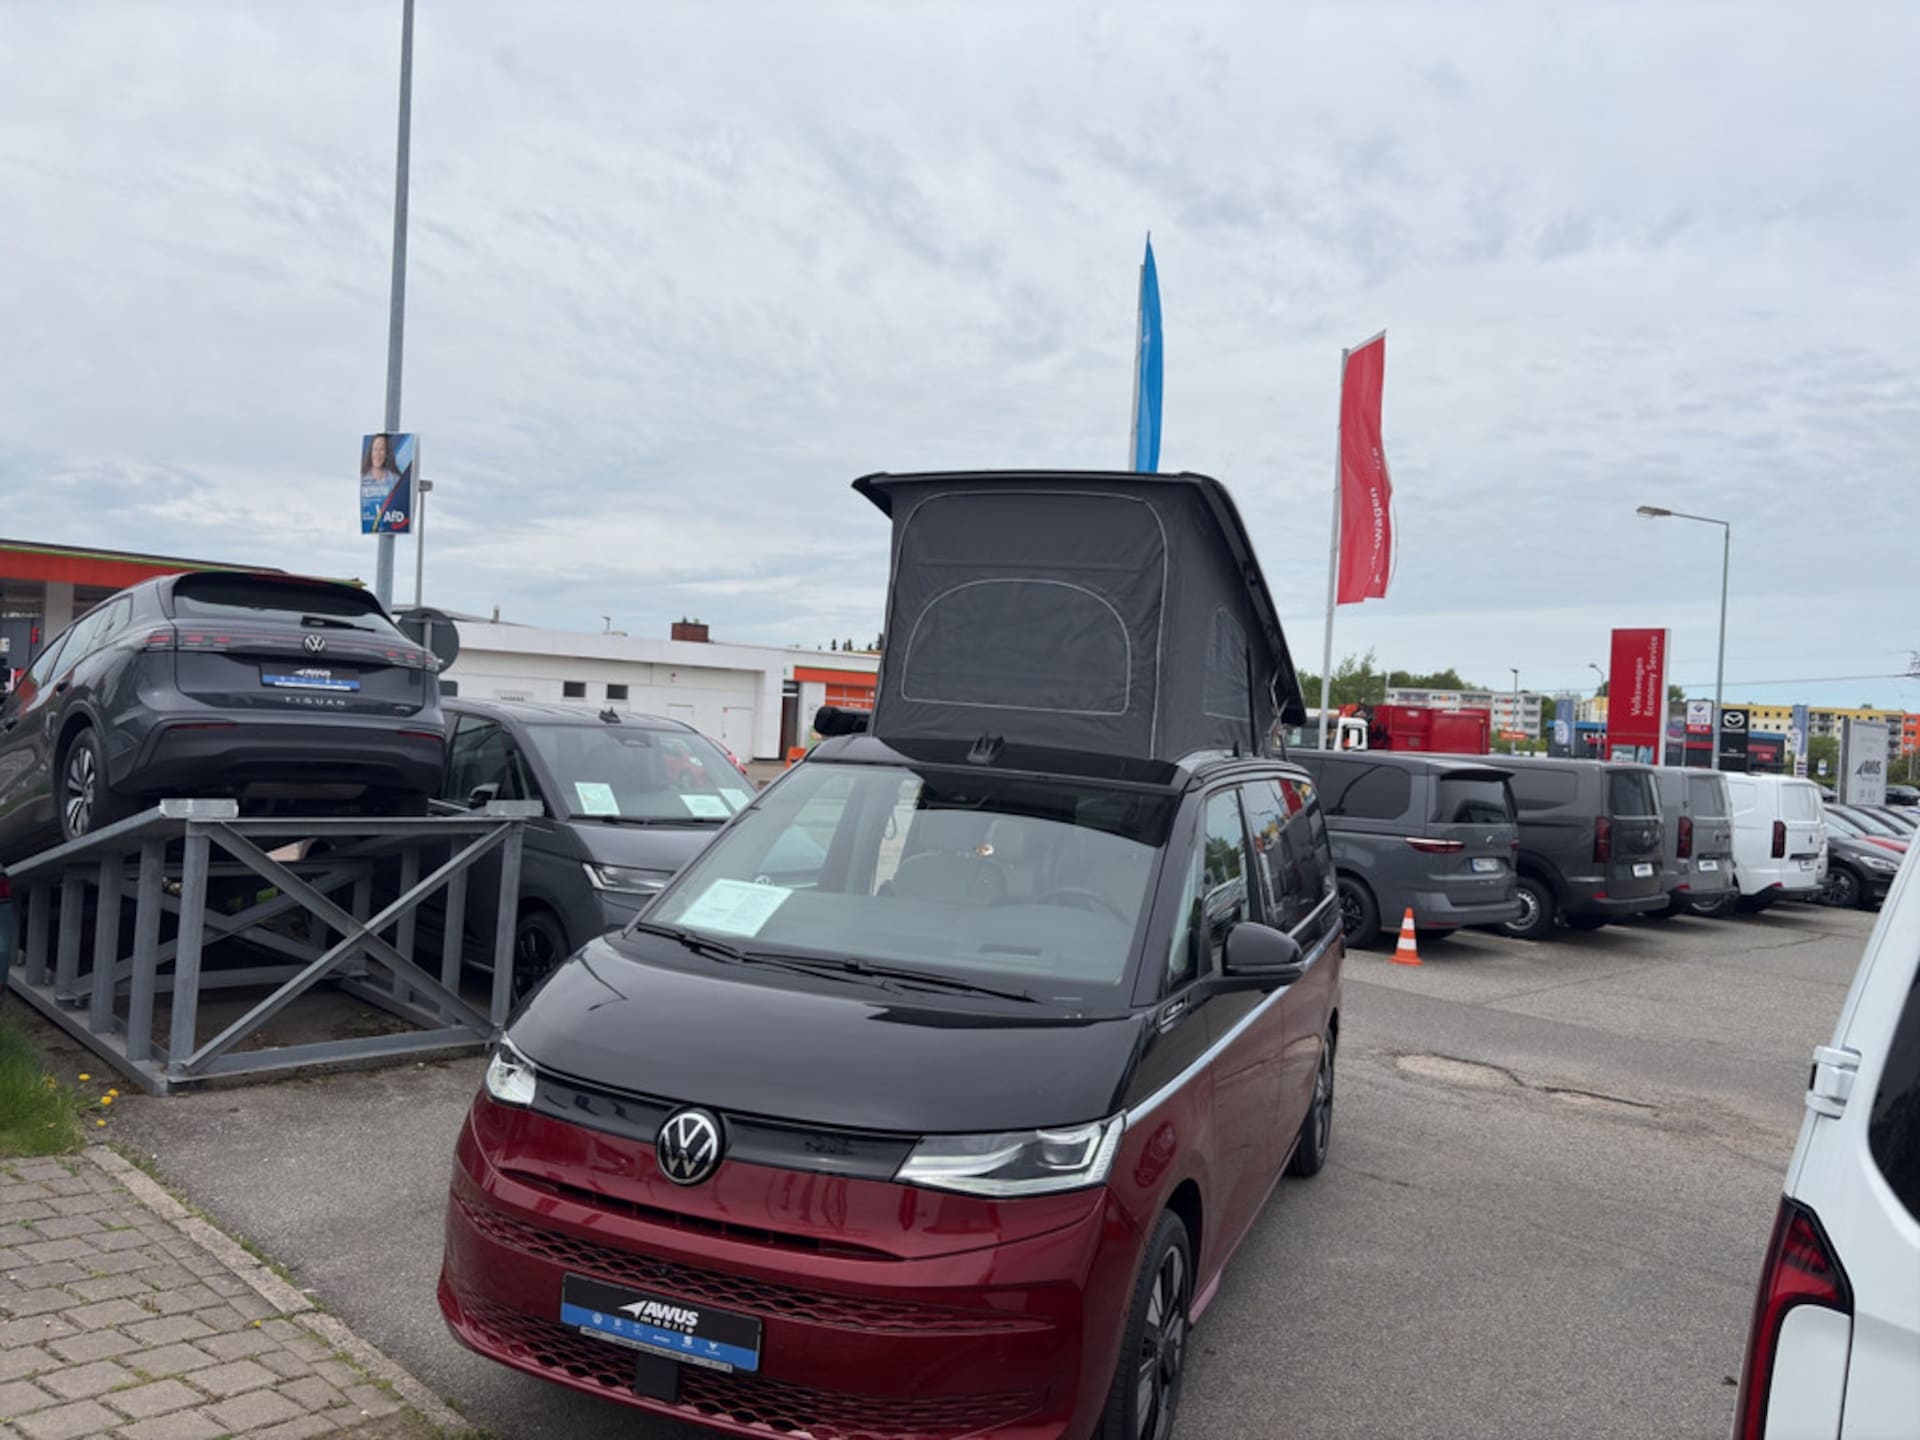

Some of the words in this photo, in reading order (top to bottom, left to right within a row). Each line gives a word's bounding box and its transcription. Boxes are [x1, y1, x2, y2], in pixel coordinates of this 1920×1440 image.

[384, 510, 405, 522] AfD
[1646, 635, 1659, 671] Service
[1631, 657, 1645, 716] Volkswagen
[1644, 672, 1658, 717] Economy
[640, 1315, 694, 1334] mobile
[643, 1301, 699, 1327] AWUS
